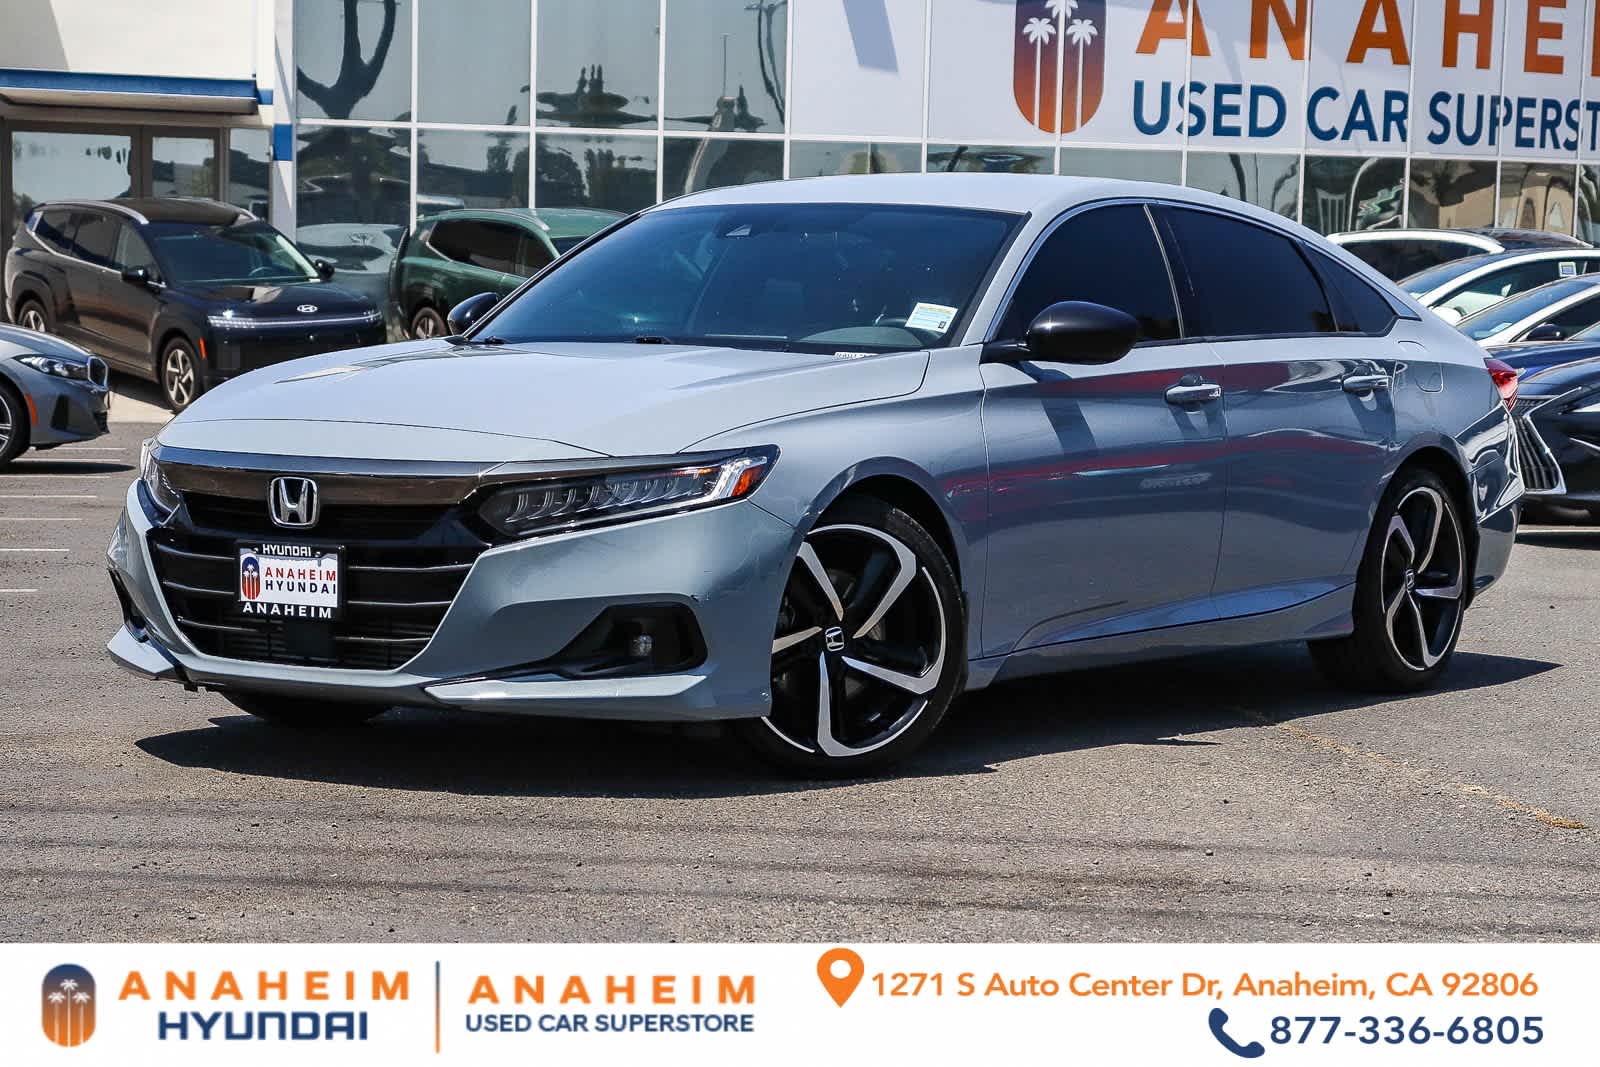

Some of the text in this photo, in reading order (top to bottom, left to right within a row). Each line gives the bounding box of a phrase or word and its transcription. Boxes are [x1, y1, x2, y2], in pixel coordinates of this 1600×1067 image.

[1132, 80, 1600, 152] USED CAR SUPERST
[262, 543, 312, 557] HYUNDAI
[264, 567, 336, 582] ANAHEIM
[265, 579, 336, 595] HYUNDAI
[242, 601, 332, 619] ANAHEIM
